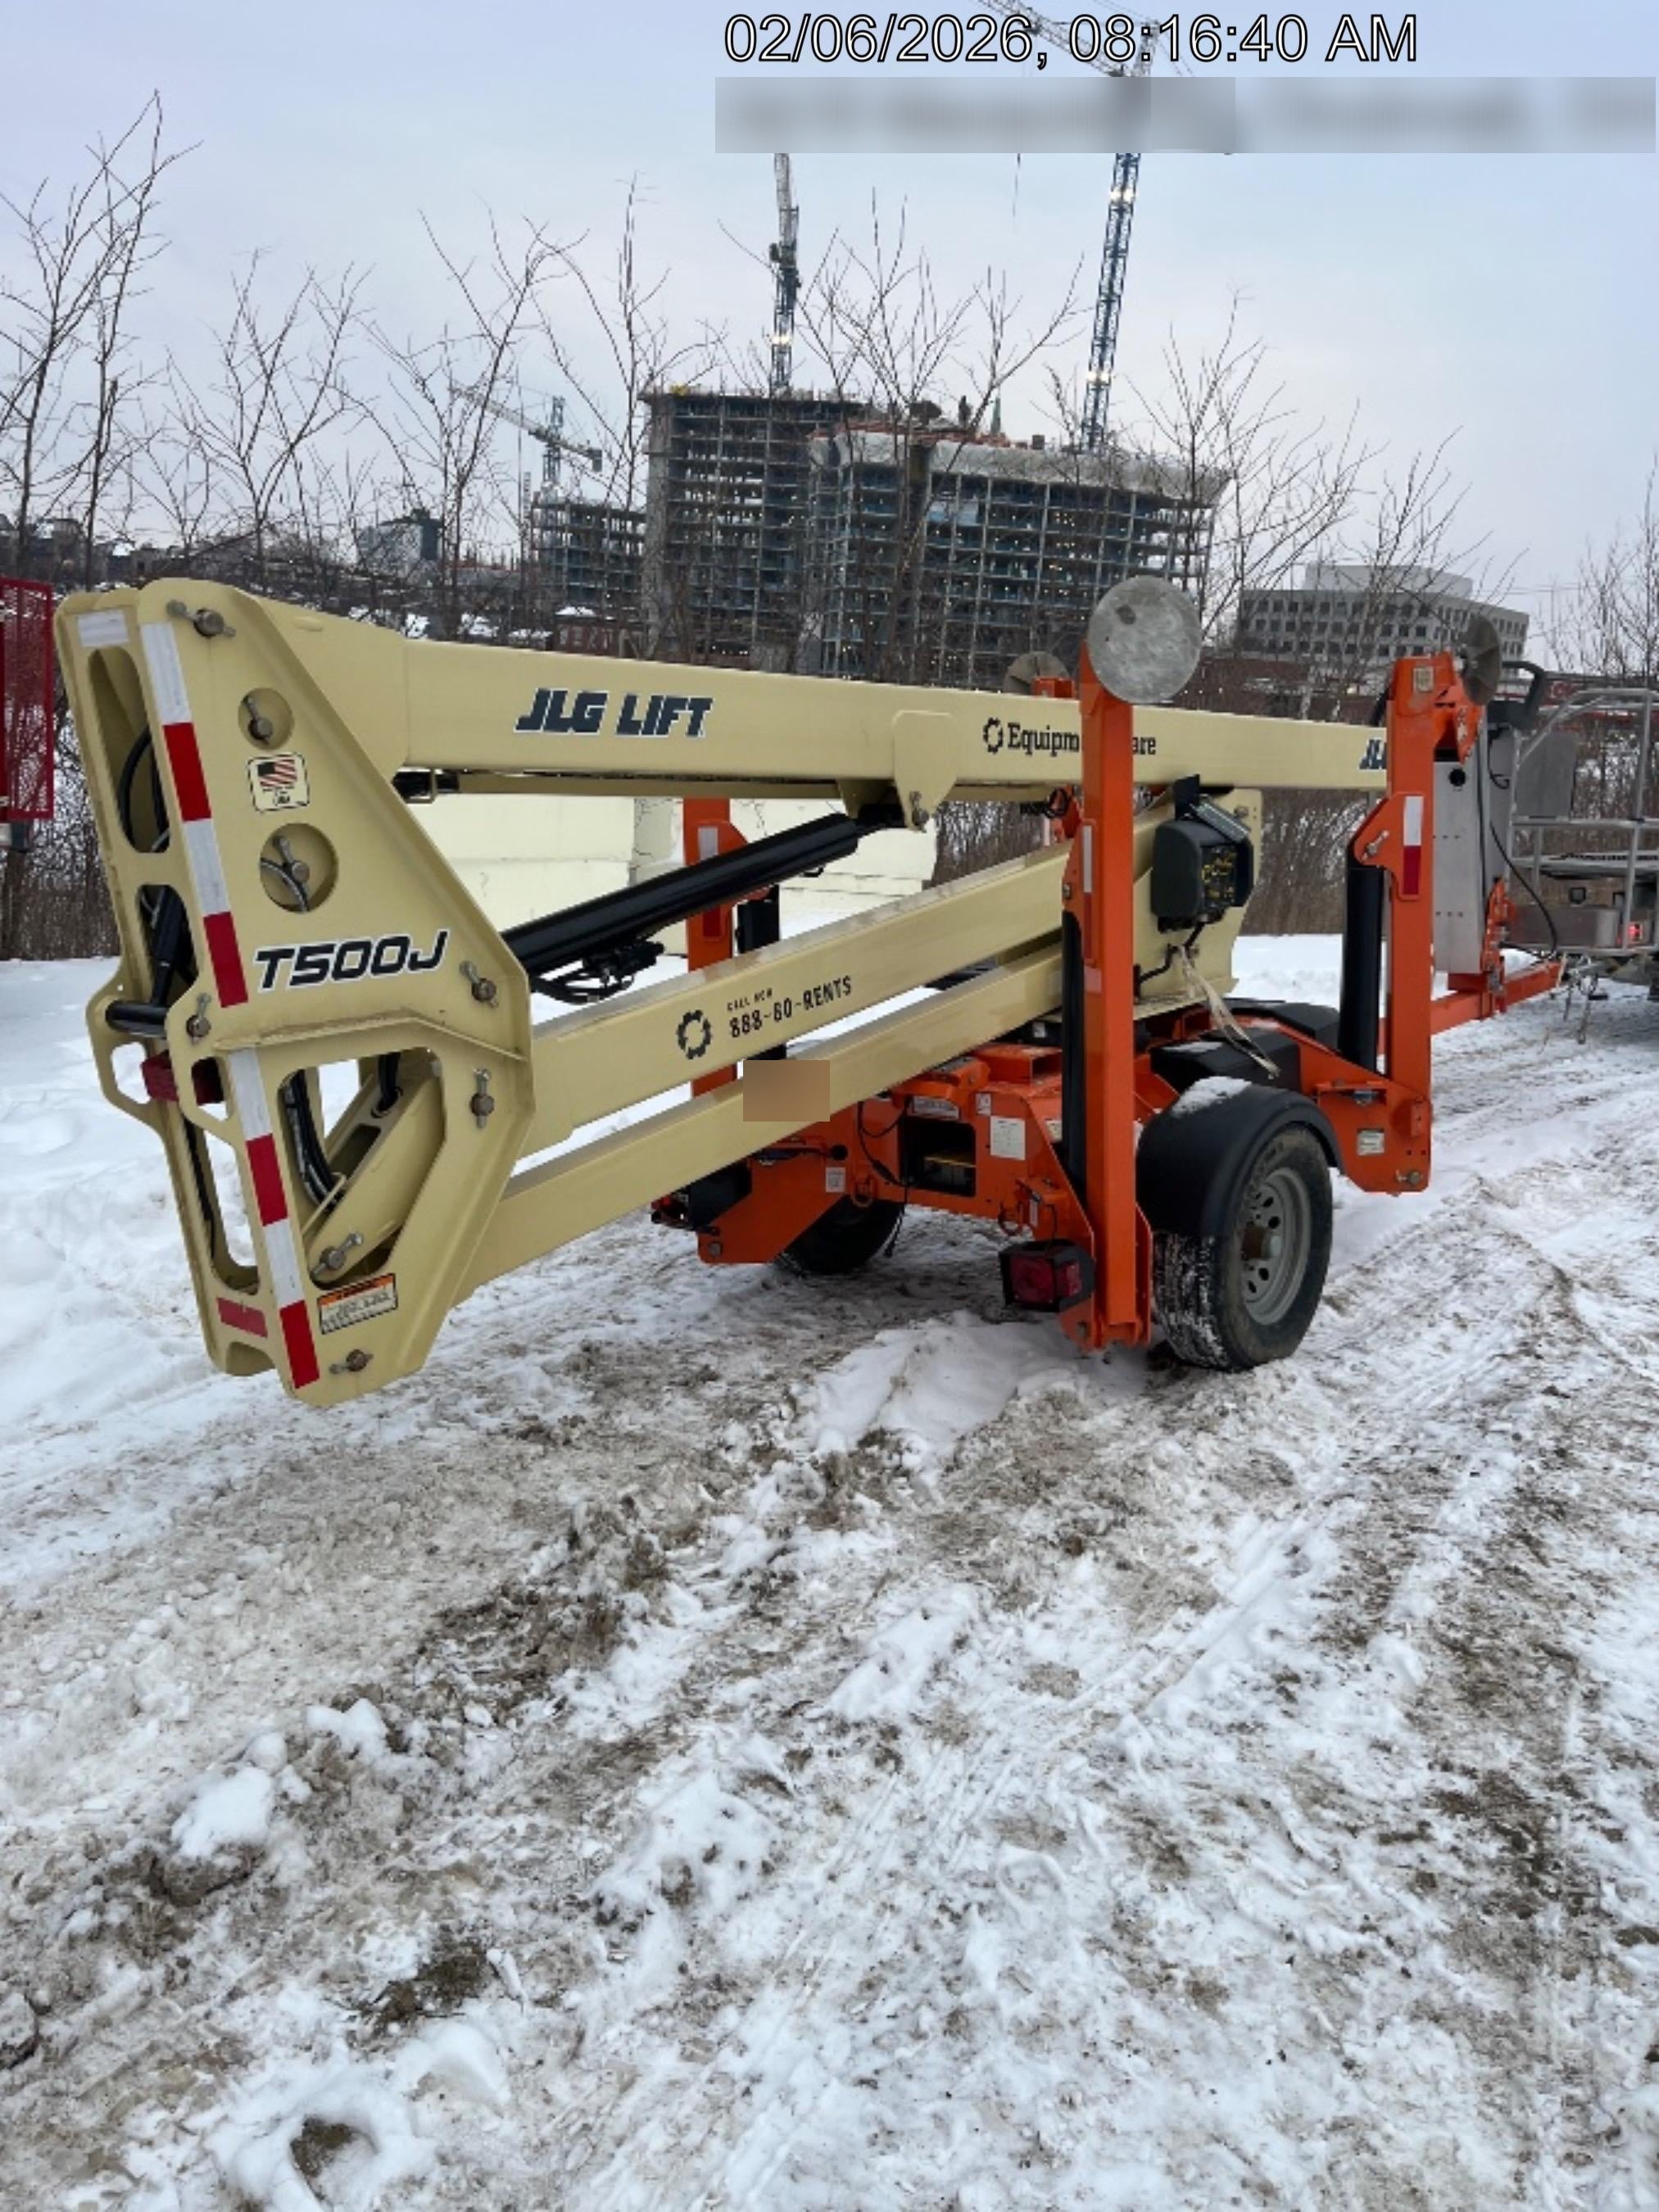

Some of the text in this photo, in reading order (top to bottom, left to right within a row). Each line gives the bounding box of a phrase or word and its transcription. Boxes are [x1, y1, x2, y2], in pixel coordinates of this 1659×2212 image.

[515, 687, 714, 738] JLG LIFT
[1008, 722, 1156, 756] Equipmare
[1359, 738, 1386, 770] JL
[256, 931, 448, 989] T500J
